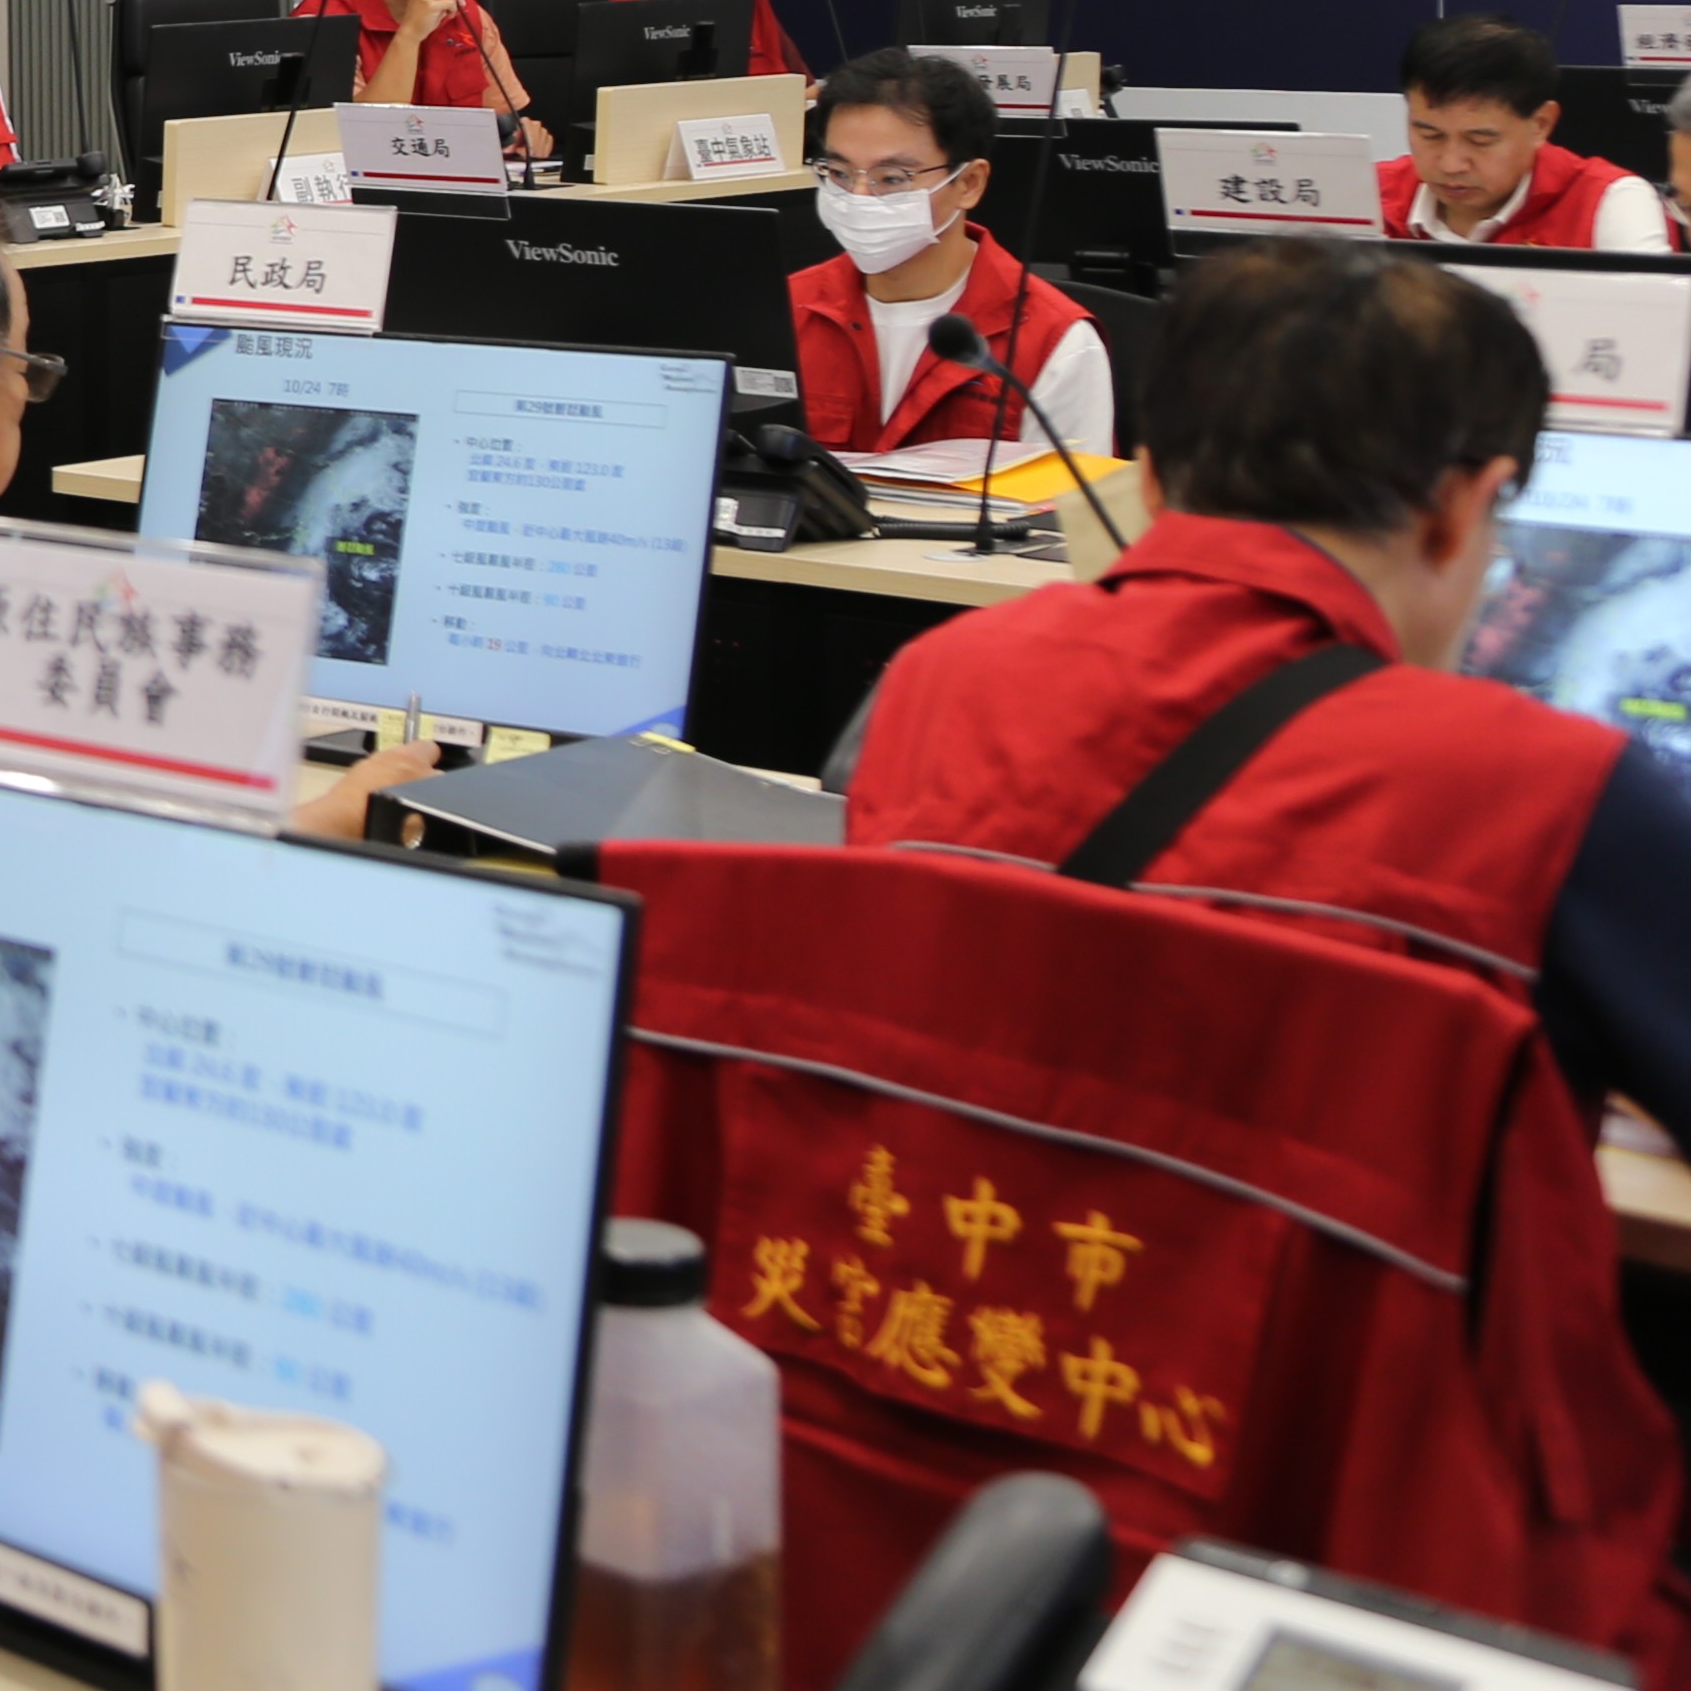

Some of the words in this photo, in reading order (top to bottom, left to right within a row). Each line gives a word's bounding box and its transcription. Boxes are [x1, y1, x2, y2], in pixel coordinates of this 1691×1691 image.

[391, 137, 450, 158] 交通局
[1058, 153, 1161, 173] ViewSonic
[1217, 173, 1321, 208] 建設局
[504, 238, 619, 267] ViewSonic
[228, 255, 327, 294] 民政局
[235, 333, 314, 360] 颱風現況
[282, 378, 322, 396] 10/24
[36, 652, 179, 727] 委員會
[848, 1144, 1144, 1311] 臺中市
[742, 1235, 1225, 1468] 災害應變中心
